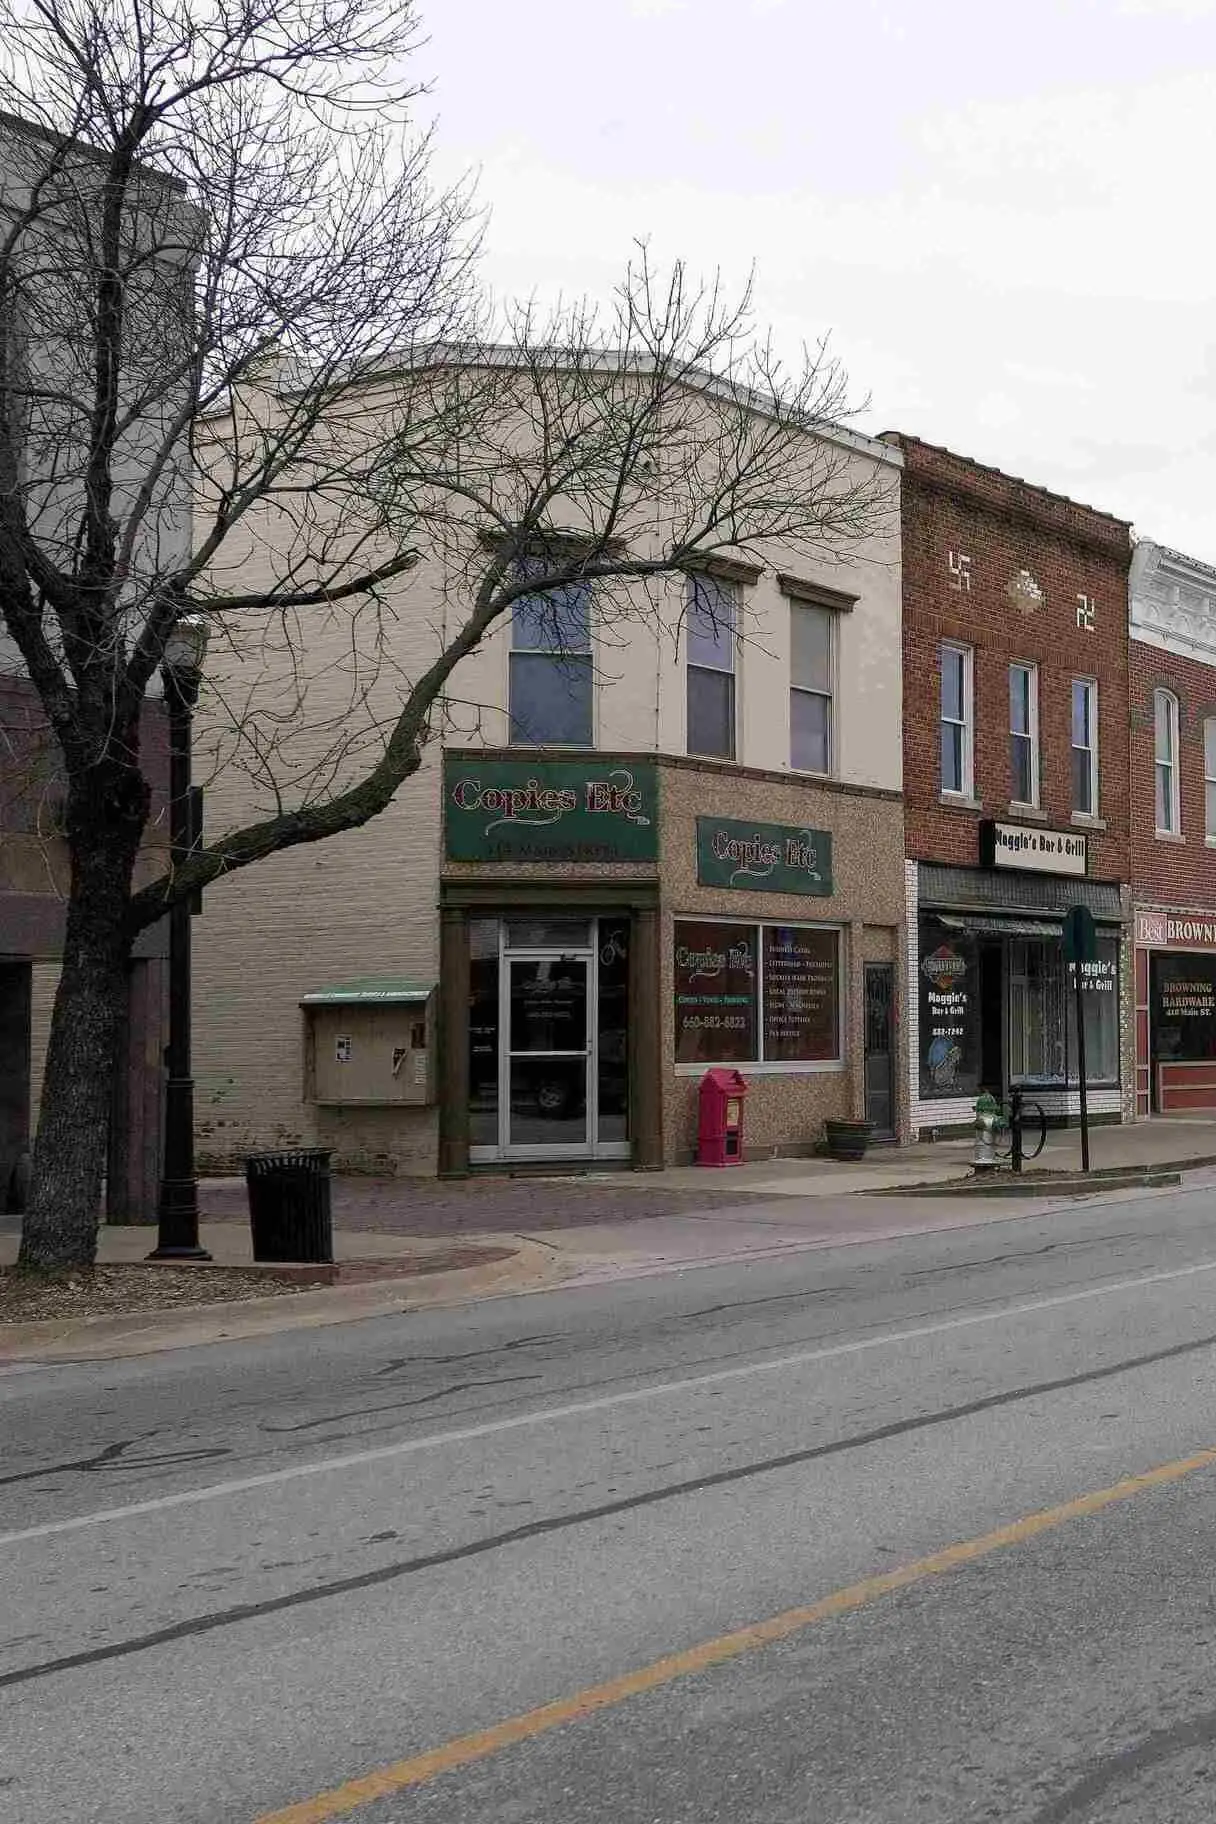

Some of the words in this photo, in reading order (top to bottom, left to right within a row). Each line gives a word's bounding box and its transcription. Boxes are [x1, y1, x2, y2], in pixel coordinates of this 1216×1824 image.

[452, 777, 577, 824] Copies
[585, 775, 644, 818] Etc
[711, 830, 781, 876] Copies
[783, 834, 819, 874] Etc
[1040, 834, 1055, 852] Bar
[1065, 838, 1084, 856] Grill
[1139, 918, 1163, 941] Best
[1096, 980, 1112, 990] Grill
[1163, 982, 1212, 993] BROWNING
[928, 991, 967, 1005] Maggie's
[1162, 996, 1215, 1007] HARDWARE
